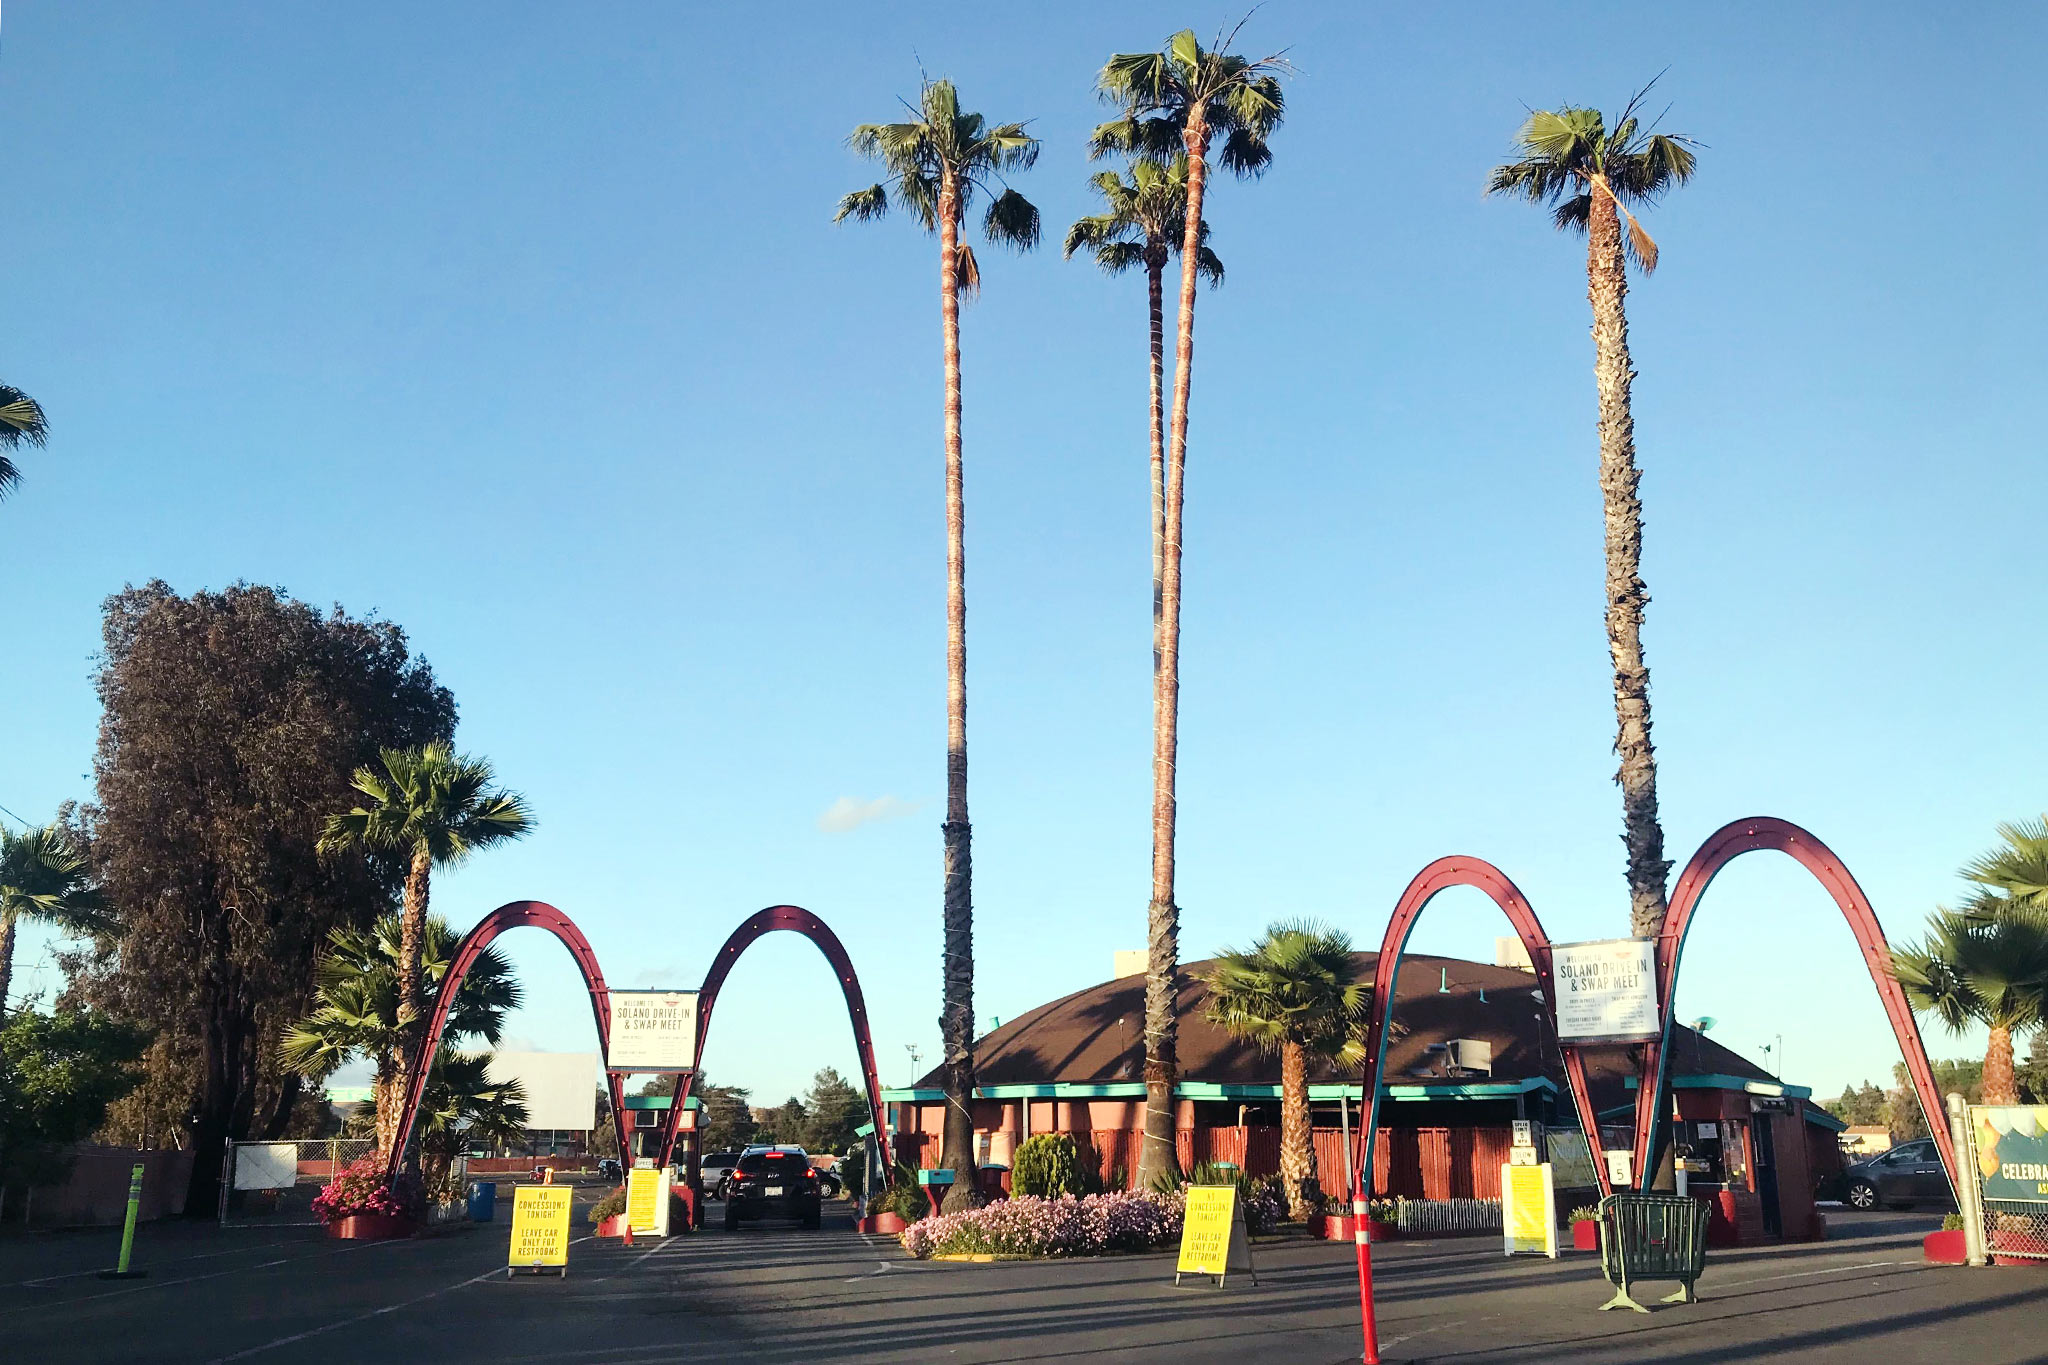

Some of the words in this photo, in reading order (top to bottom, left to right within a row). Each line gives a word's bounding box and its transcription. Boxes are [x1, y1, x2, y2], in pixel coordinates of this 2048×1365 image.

[1560, 963, 1599, 978] SOLANO
[1602, 959, 1647, 976] DRIVE-IN
[1571, 978, 1578, 992] &
[1581, 977, 1609, 991] SWAP
[1613, 974, 1639, 989] MEET
[617, 1008, 650, 1018] SOLANO
[653, 1008, 690, 1019] DRIVE-IN
[624, 1020, 630, 1030] &
[633, 1020, 657, 1030] SWAP
[660, 1020, 682, 1030] MEET
[1616, 1169, 1624, 1180] 5
[538, 1192, 548, 1200] NO
[518, 1200, 566, 1209] CONCESSIONS
[1190, 1202, 1230, 1212] CONCESSIONS
[527, 1210, 556, 1218] TONIGHT
[1197, 1212, 1221, 1221] TONIGHT
[521, 1228, 542, 1237] LEAVE
[544, 1229, 558, 1237] CAR
[1190, 1231, 1208, 1241] LEAVE
[1210, 1232, 1222, 1241] CAR
[522, 1238, 540, 1246] ONLY
[542, 1238, 555, 1246] FOR
[1191, 1242, 1206, 1250] ONLY
[1207, 1242, 1219, 1251] FOR
[517, 1247, 559, 1256] RESTROOMS
[1186, 1251, 1221, 1262] RESTROOMS
